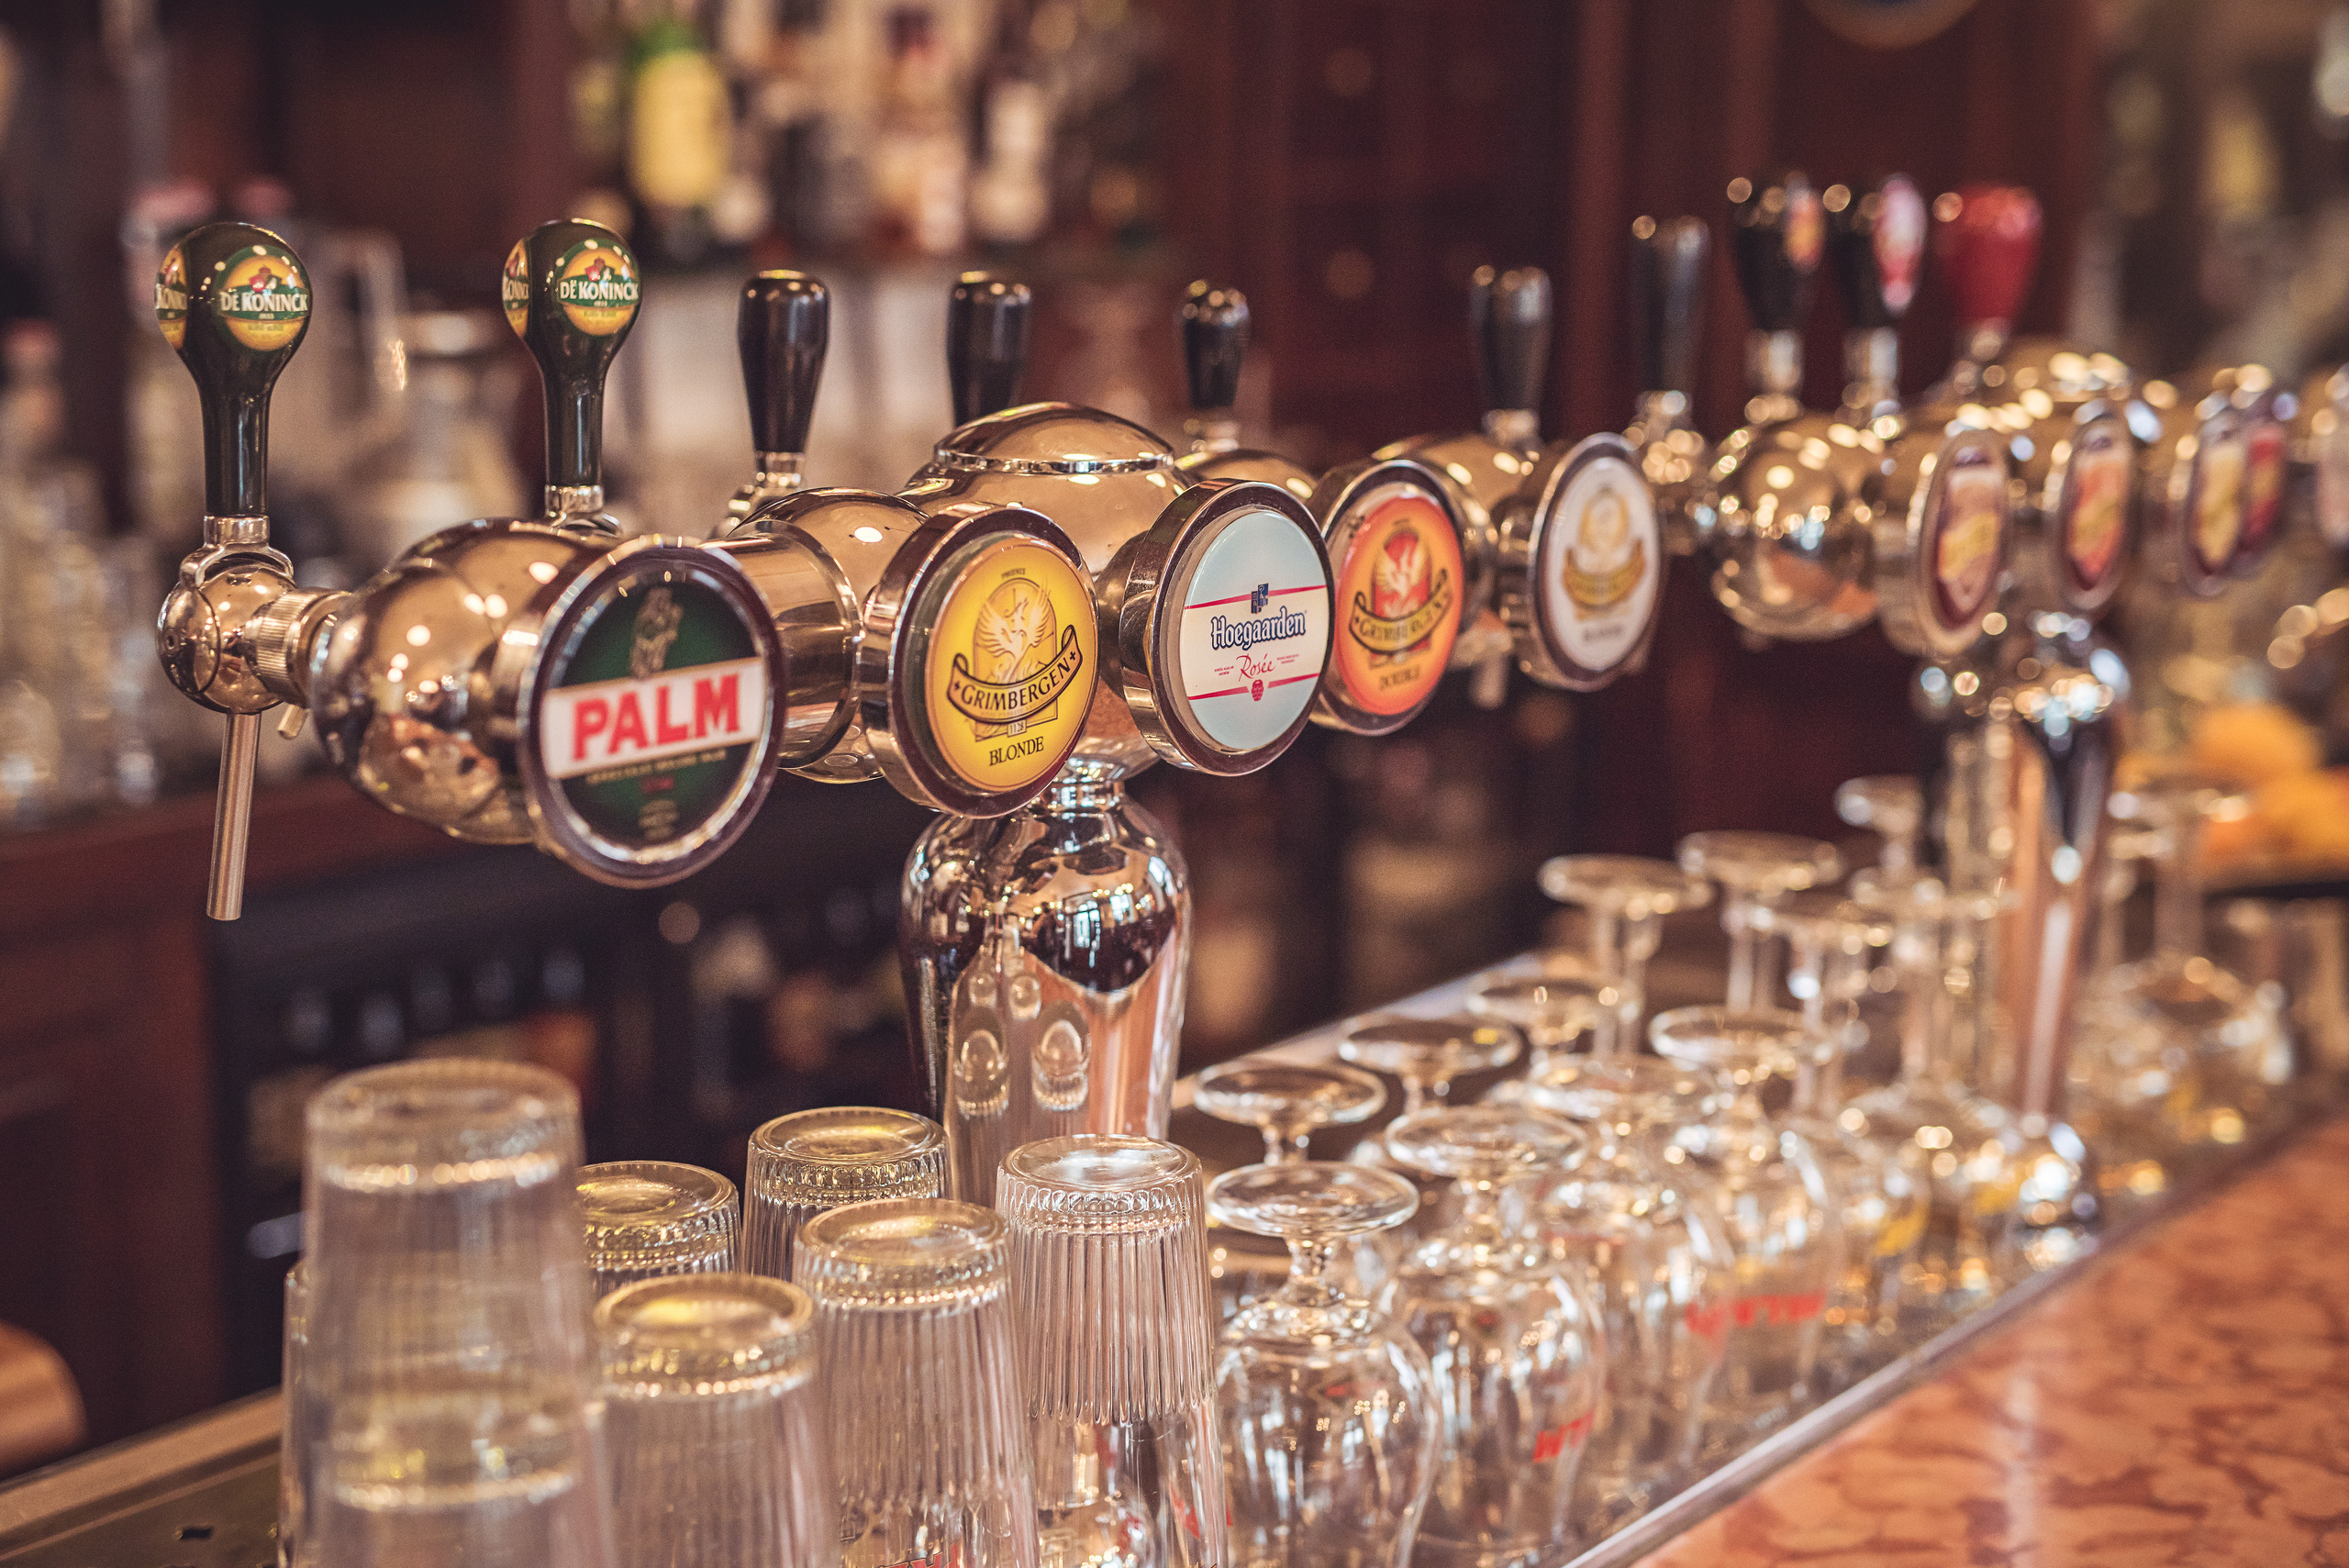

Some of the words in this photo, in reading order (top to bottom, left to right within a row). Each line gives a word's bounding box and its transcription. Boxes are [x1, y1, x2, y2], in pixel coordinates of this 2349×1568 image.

[220, 291, 240, 311] DE
[241, 291, 308, 312] KONINCK
[560, 281, 577, 299] DE
[578, 281, 639, 301] KONINCK
[1211, 606, 1306, 651] Hoegaarden
[1235, 652, 1276, 682] Rosée
[961, 657, 1071, 711] GRIMBERGEN
[573, 673, 741, 762] PALM
[989, 736, 1044, 766] BLONDE
